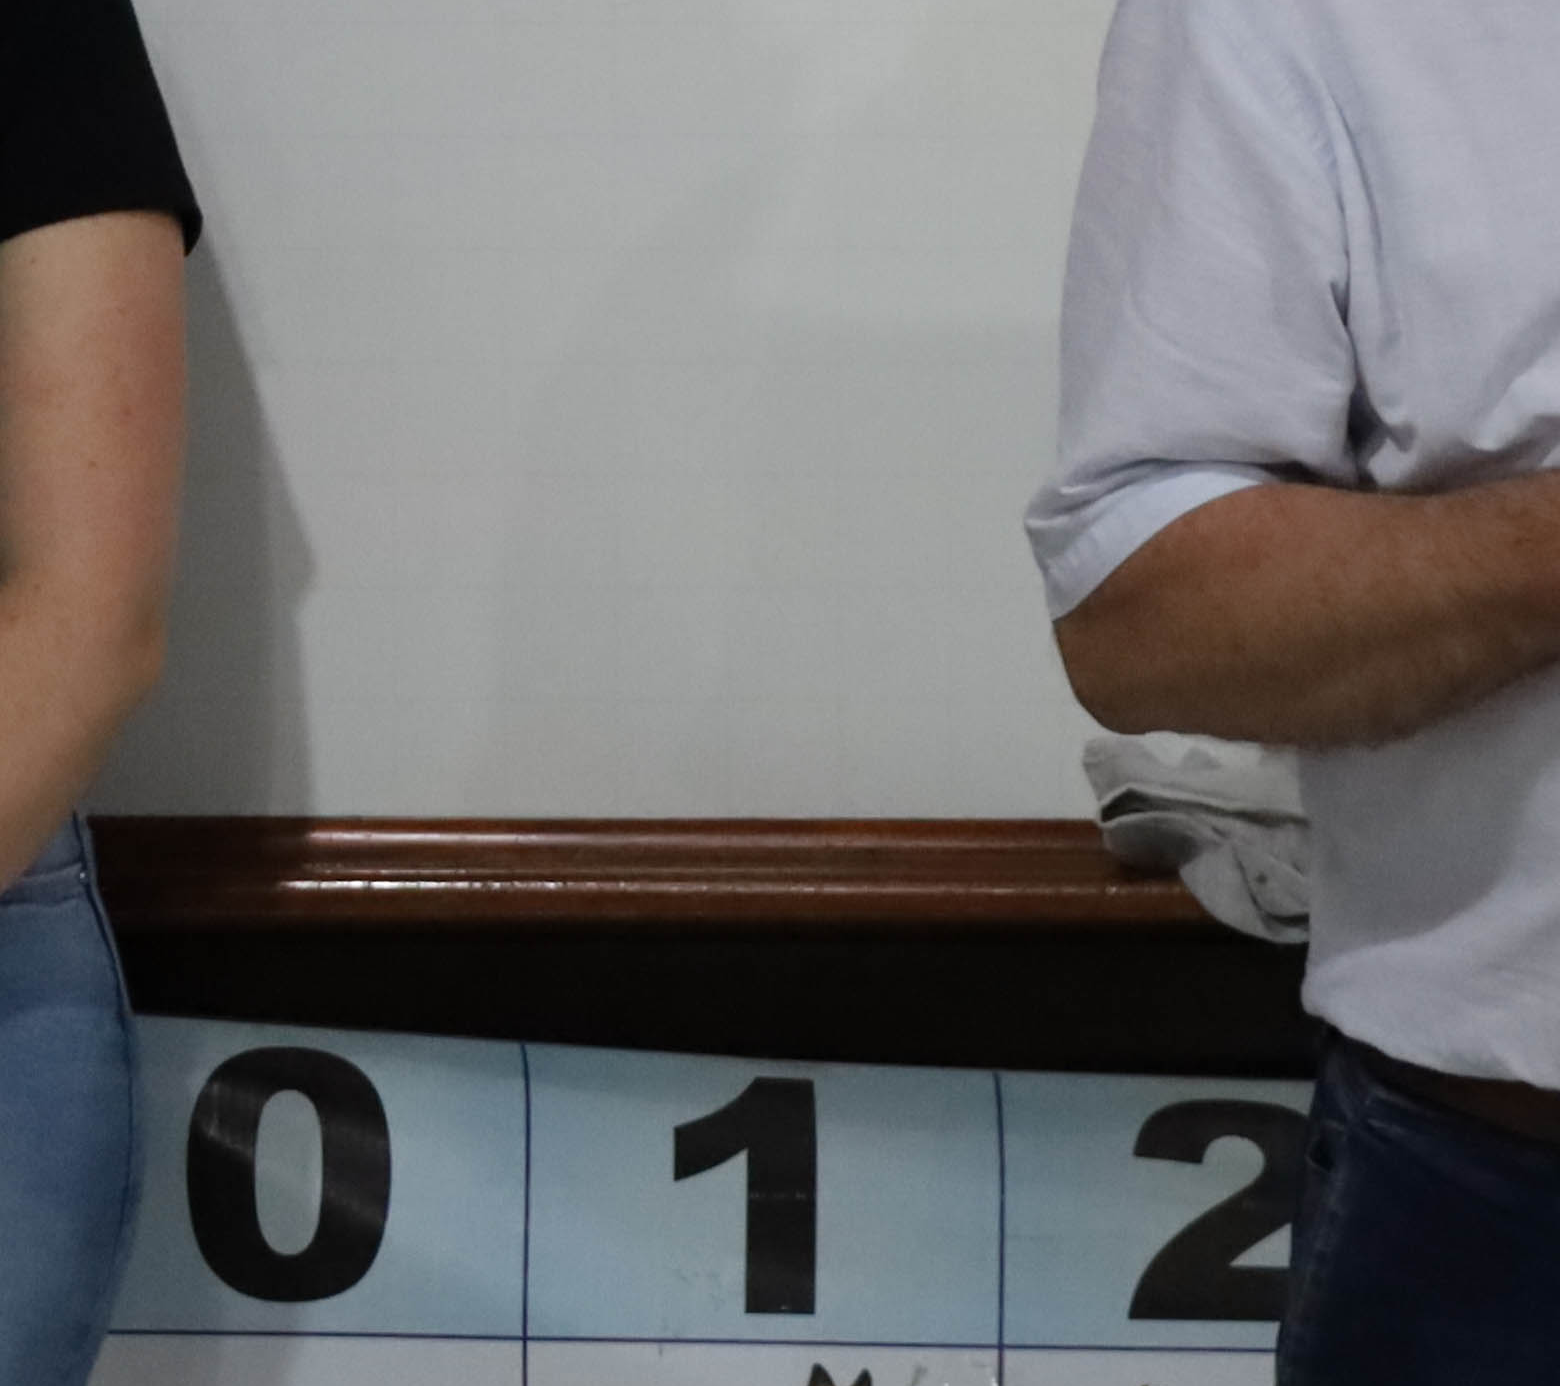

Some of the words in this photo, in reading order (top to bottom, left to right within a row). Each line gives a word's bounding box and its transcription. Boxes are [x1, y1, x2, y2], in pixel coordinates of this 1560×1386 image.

[185, 1045, 393, 1303] 0
[672, 1076, 818, 1315] 1
[1126, 1098, 1312, 1323] 2
